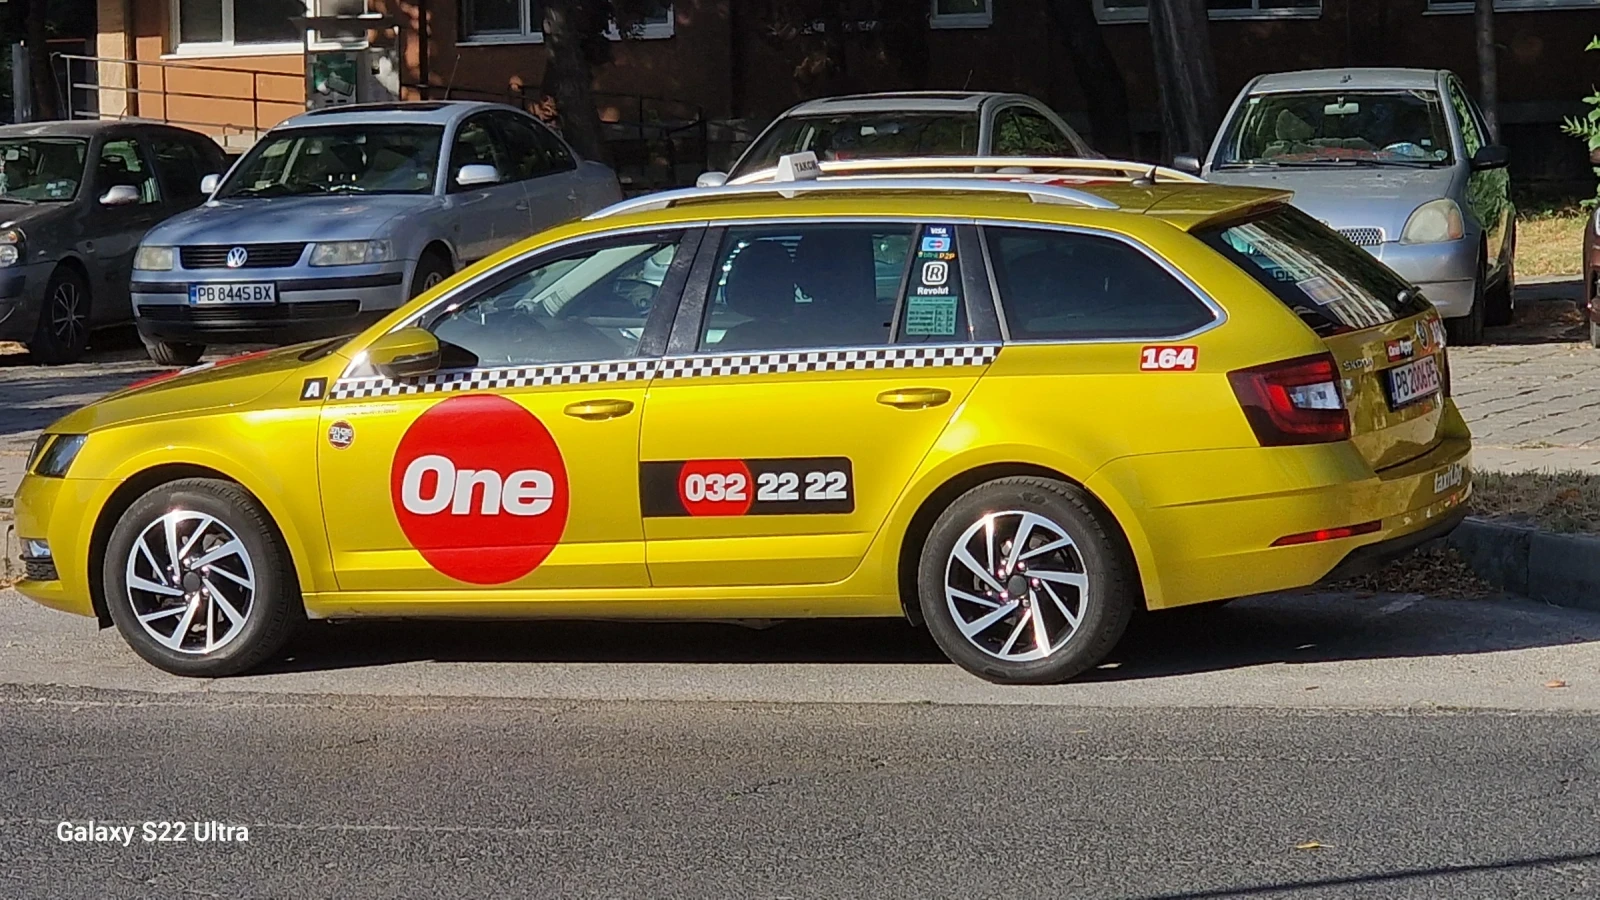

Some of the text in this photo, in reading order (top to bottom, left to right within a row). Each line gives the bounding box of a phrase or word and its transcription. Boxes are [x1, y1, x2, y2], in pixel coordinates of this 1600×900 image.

[197, 285, 273, 302] PB 8445 BX
[917, 287, 949, 295] Revolut
[1142, 348, 1194, 369] 164
[304, 381, 320, 398] A
[401, 454, 554, 516] One
[684, 471, 848, 501] 032 22 22
